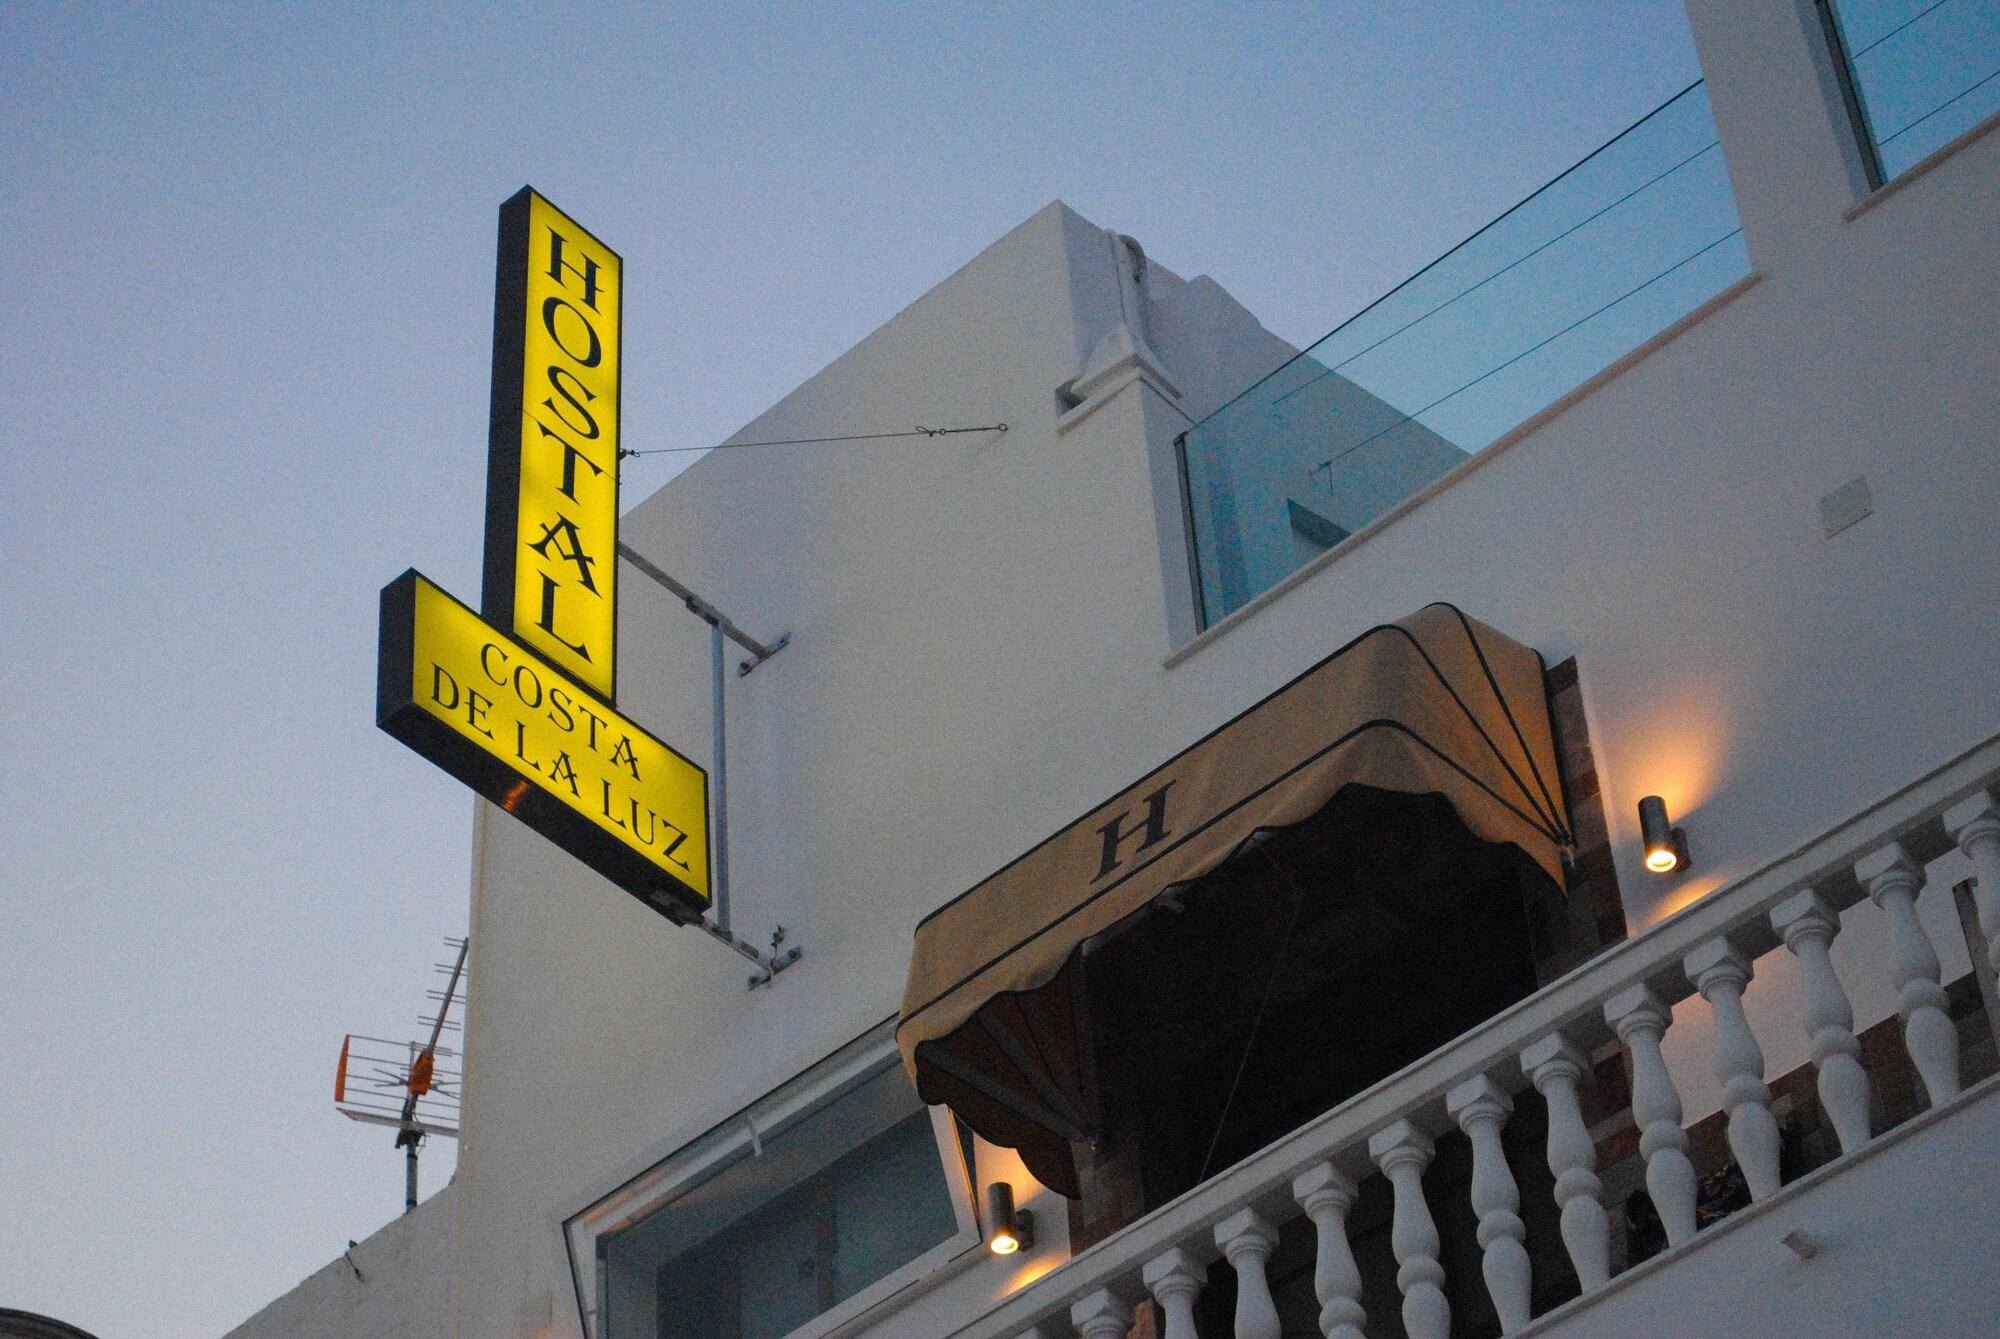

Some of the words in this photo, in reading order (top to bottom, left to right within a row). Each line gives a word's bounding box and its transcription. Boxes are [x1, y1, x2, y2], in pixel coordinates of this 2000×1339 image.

[525, 224, 604, 664] HOSTAL
[431, 662, 494, 740] DE
[515, 720, 582, 800] LA
[601, 778, 690, 872] LUZ
[480, 643, 642, 783] COSTA
[1090, 779, 1176, 885] H
